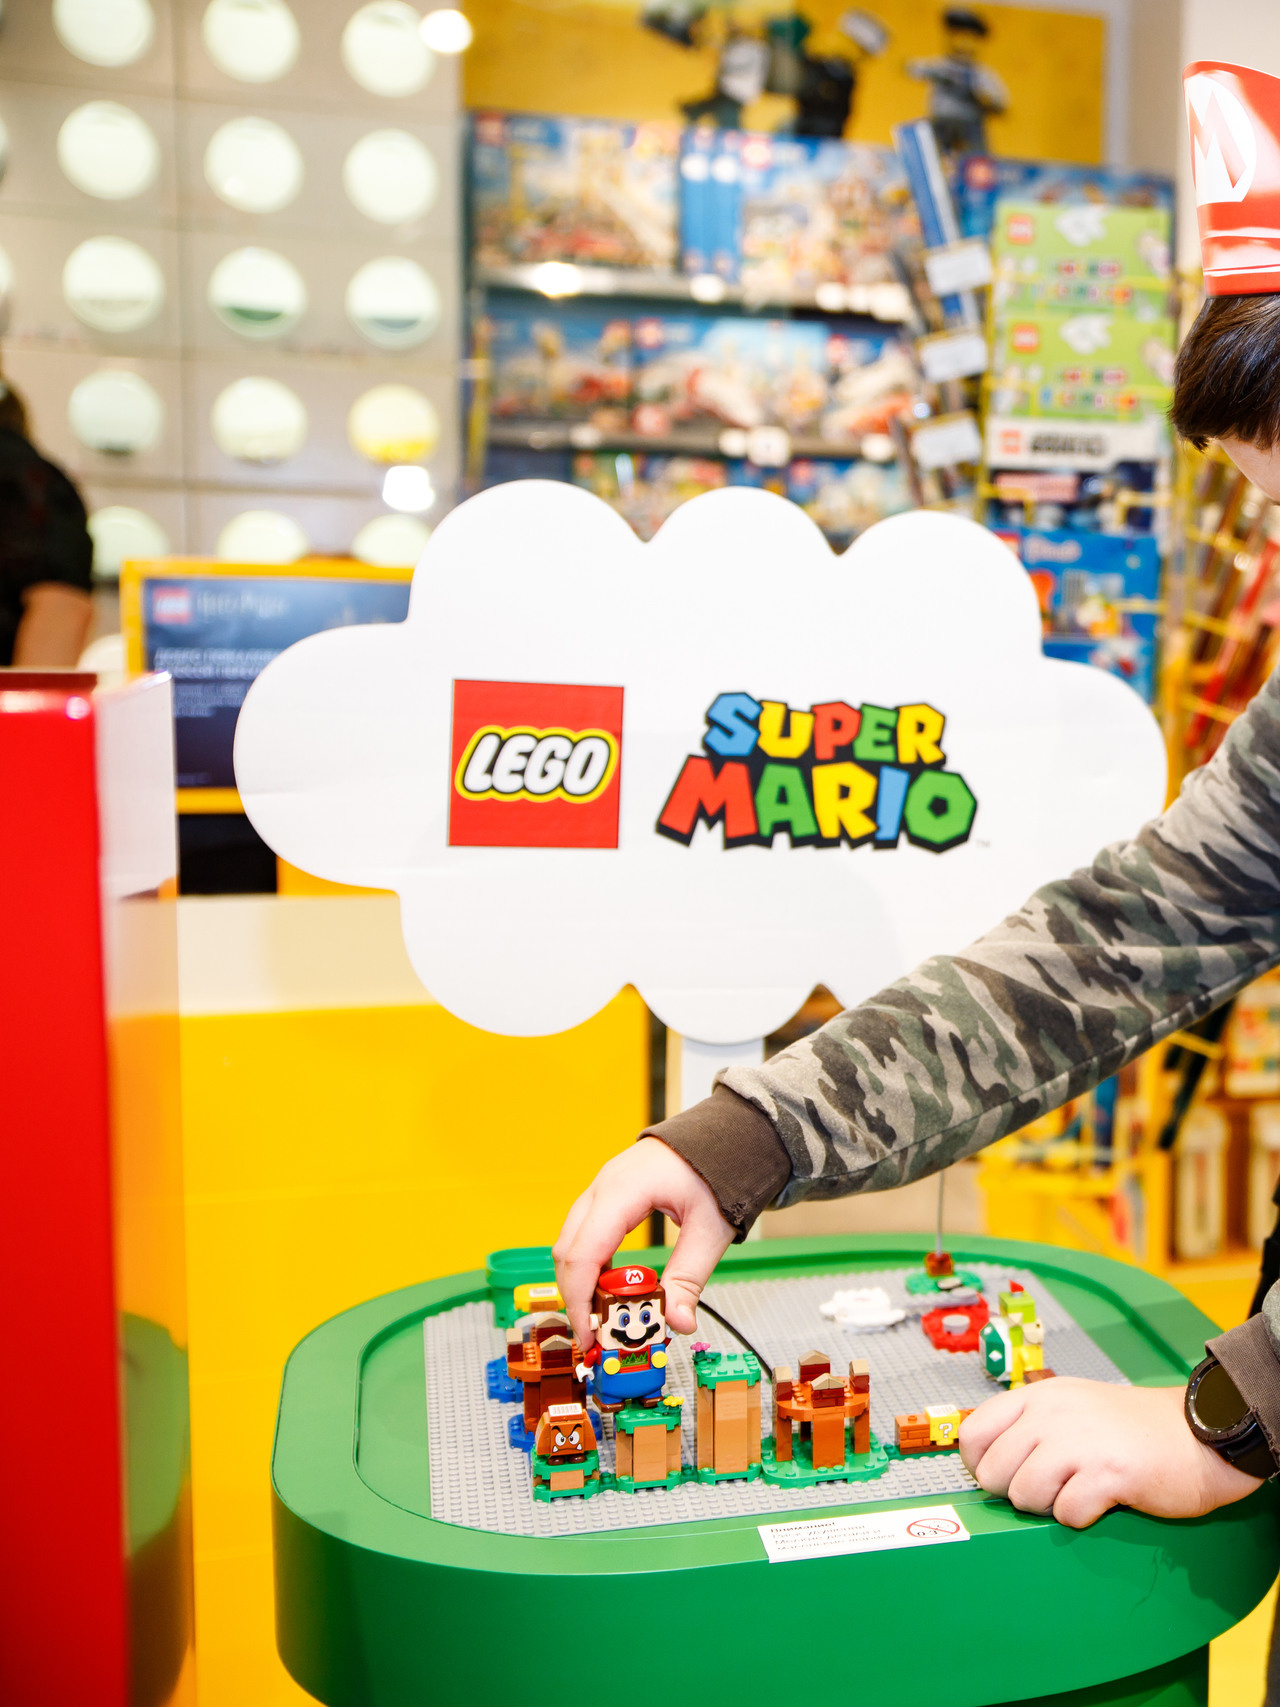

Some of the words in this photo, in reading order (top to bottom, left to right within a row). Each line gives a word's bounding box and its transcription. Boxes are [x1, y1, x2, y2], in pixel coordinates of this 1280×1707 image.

[458, 729, 613, 799] LEGO
[703, 691, 947, 767] SUPER
[655, 754, 978, 853] MARIO
